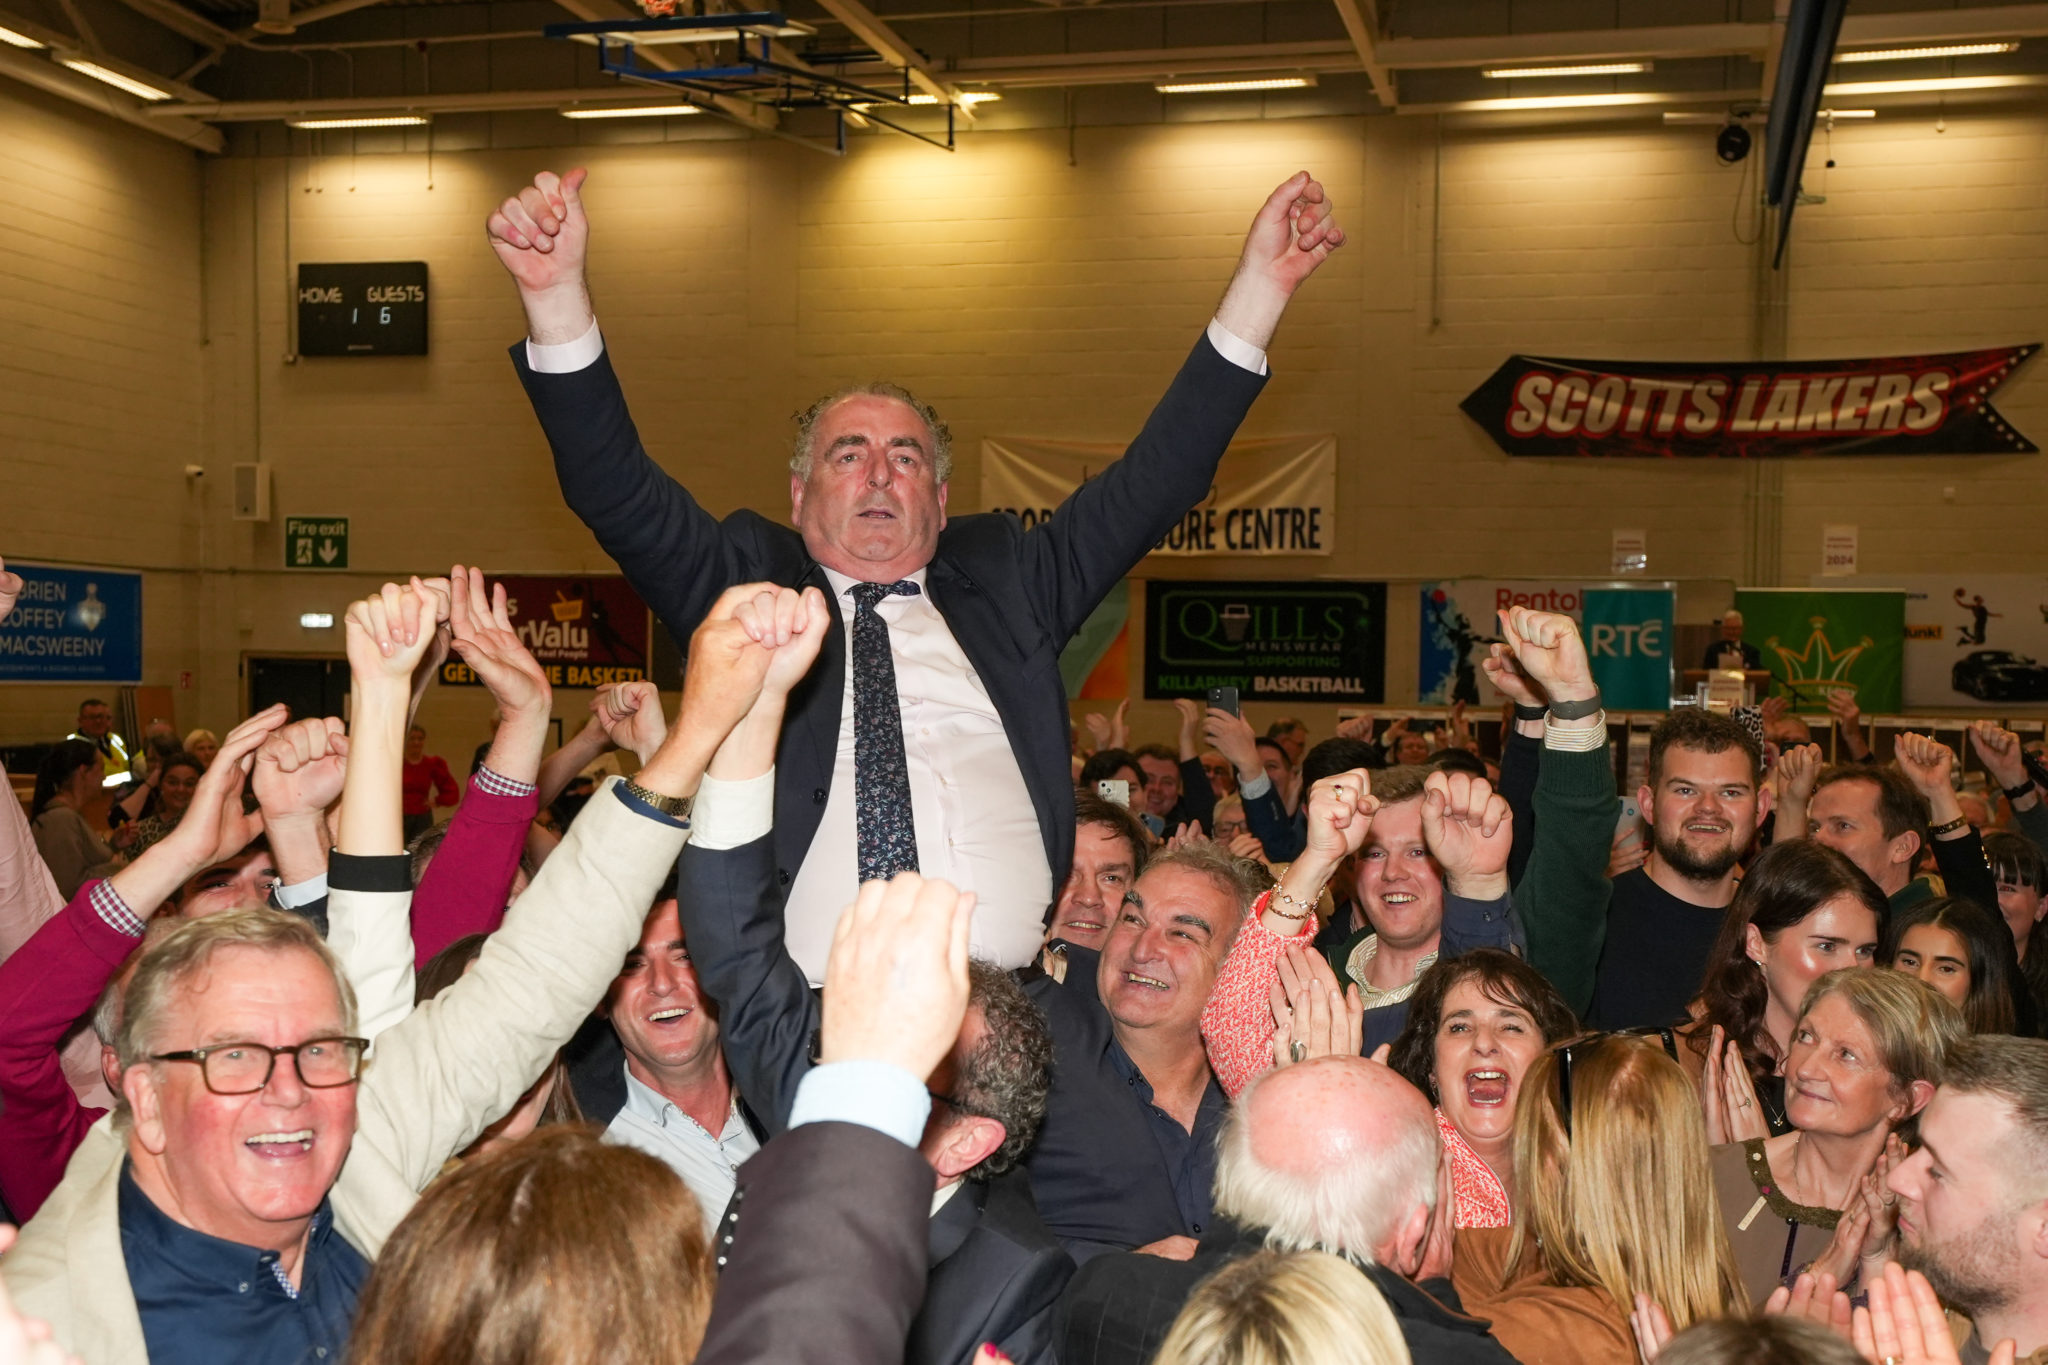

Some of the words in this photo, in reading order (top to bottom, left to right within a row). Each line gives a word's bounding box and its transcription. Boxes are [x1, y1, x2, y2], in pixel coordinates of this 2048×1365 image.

[298, 287, 343, 304] HOME
[366, 285, 425, 303] GUESTS
[380, 306, 391, 325] 6
[1511, 374, 1728, 434] SCOTTS
[1730, 371, 1950, 433] LAKERS
[288, 520, 317, 536] Fire
[319, 520, 346, 536] exit
[1225, 508, 1321, 550] CENTRE
[1245, 641, 1342, 652] MENSWEAR
[1244, 656, 1342, 668] SUPPORTING
[443, 663, 476, 683] GET
[567, 665, 644, 686] BASKET!
[1157, 674, 1252, 692] KILLARNEY
[1253, 676, 1365, 694] BASKETBALL
